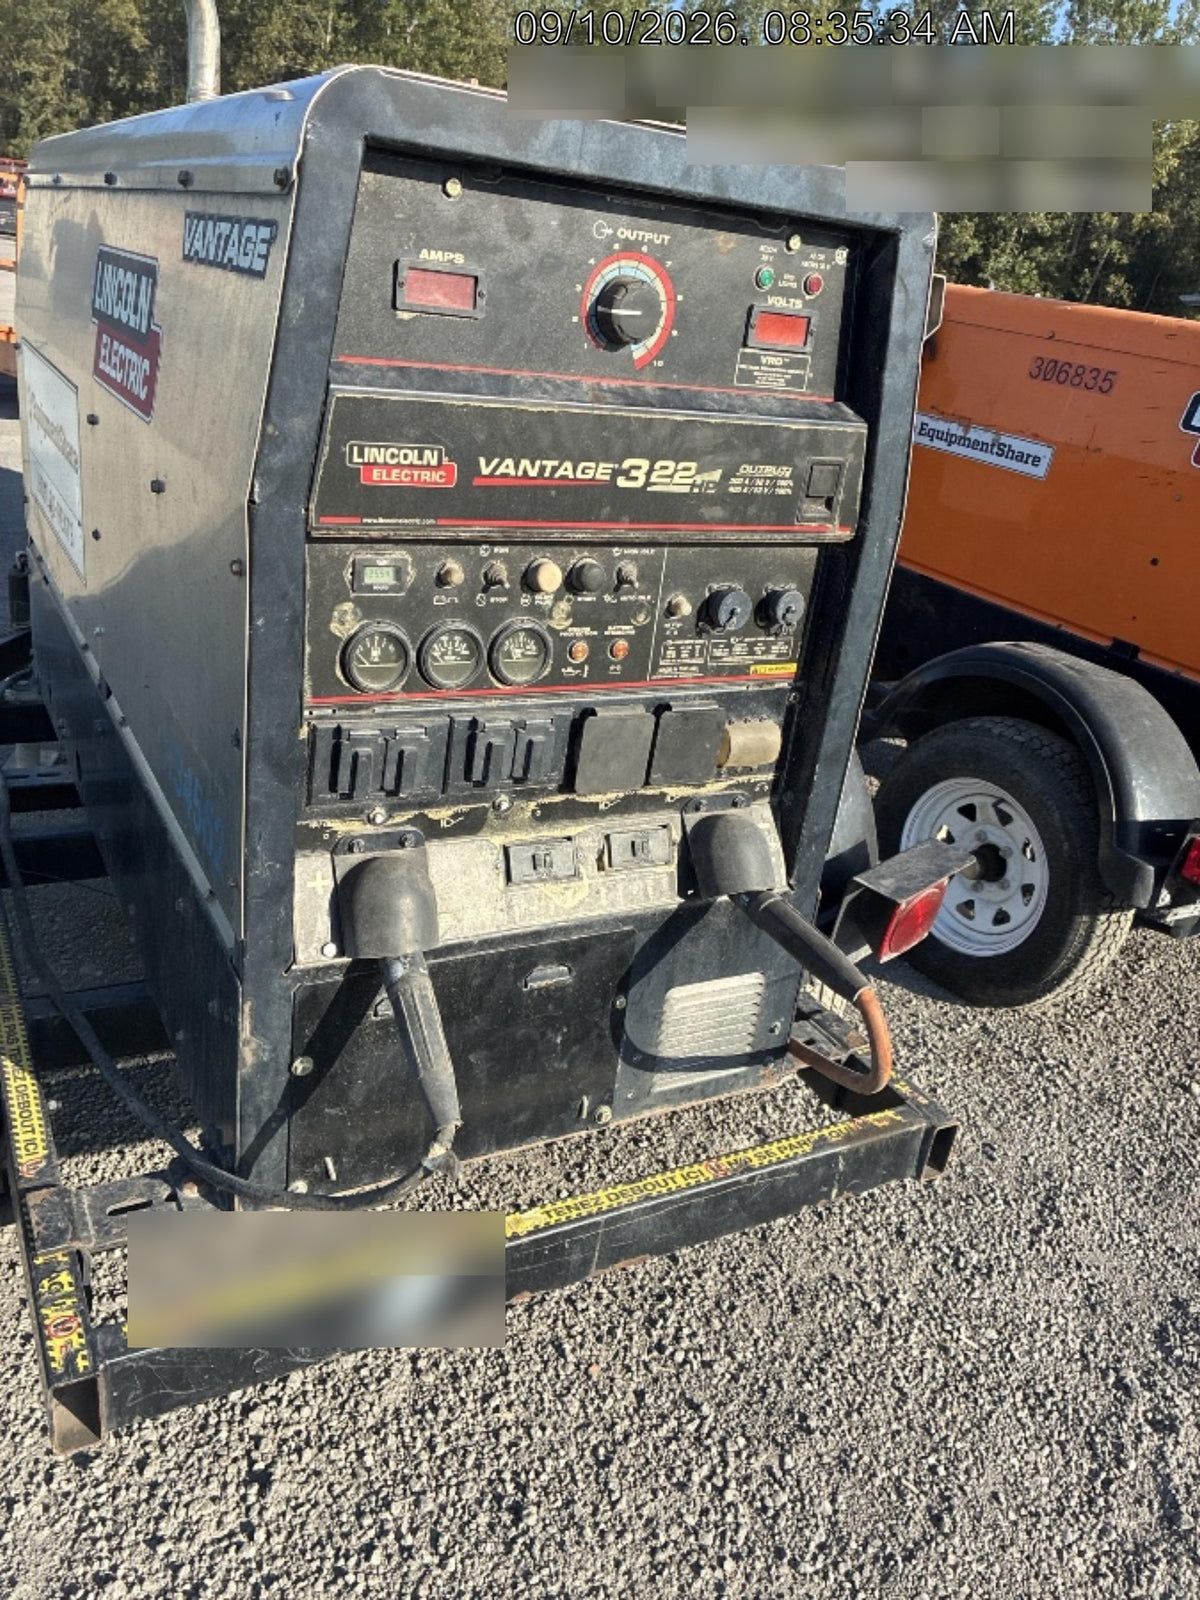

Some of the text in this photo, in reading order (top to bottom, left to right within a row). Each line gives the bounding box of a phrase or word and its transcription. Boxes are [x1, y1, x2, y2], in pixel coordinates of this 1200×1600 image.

[184, 218, 272, 272] VANTAGE
[617, 228, 671, 245] OUTPUT
[419, 248, 465, 264] AMPS
[95, 261, 152, 333] LINCOLN
[767, 295, 803, 309] VOLTS
[99, 334, 150, 401] ELECTRIC
[1029, 357, 1118, 394] 306835
[352, 446, 438, 466] LINCOLN
[918, 422, 1042, 467] EquipmentShare
[372, 468, 446, 483] ELECTRIC
[478, 456, 614, 480] VANTAGE
[616, 458, 699, 488] 322
[737, 464, 793, 479] OUTPUT
[15, 1084, 37, 1136] DEBOUT
[24, 1137, 39, 1157] ICI
[542, 1196, 605, 1220] TENEZ
[605, 1175, 679, 1202] DEBOUT
[681, 1168, 706, 1185] ICI
[754, 1148, 776, 1161] SE
